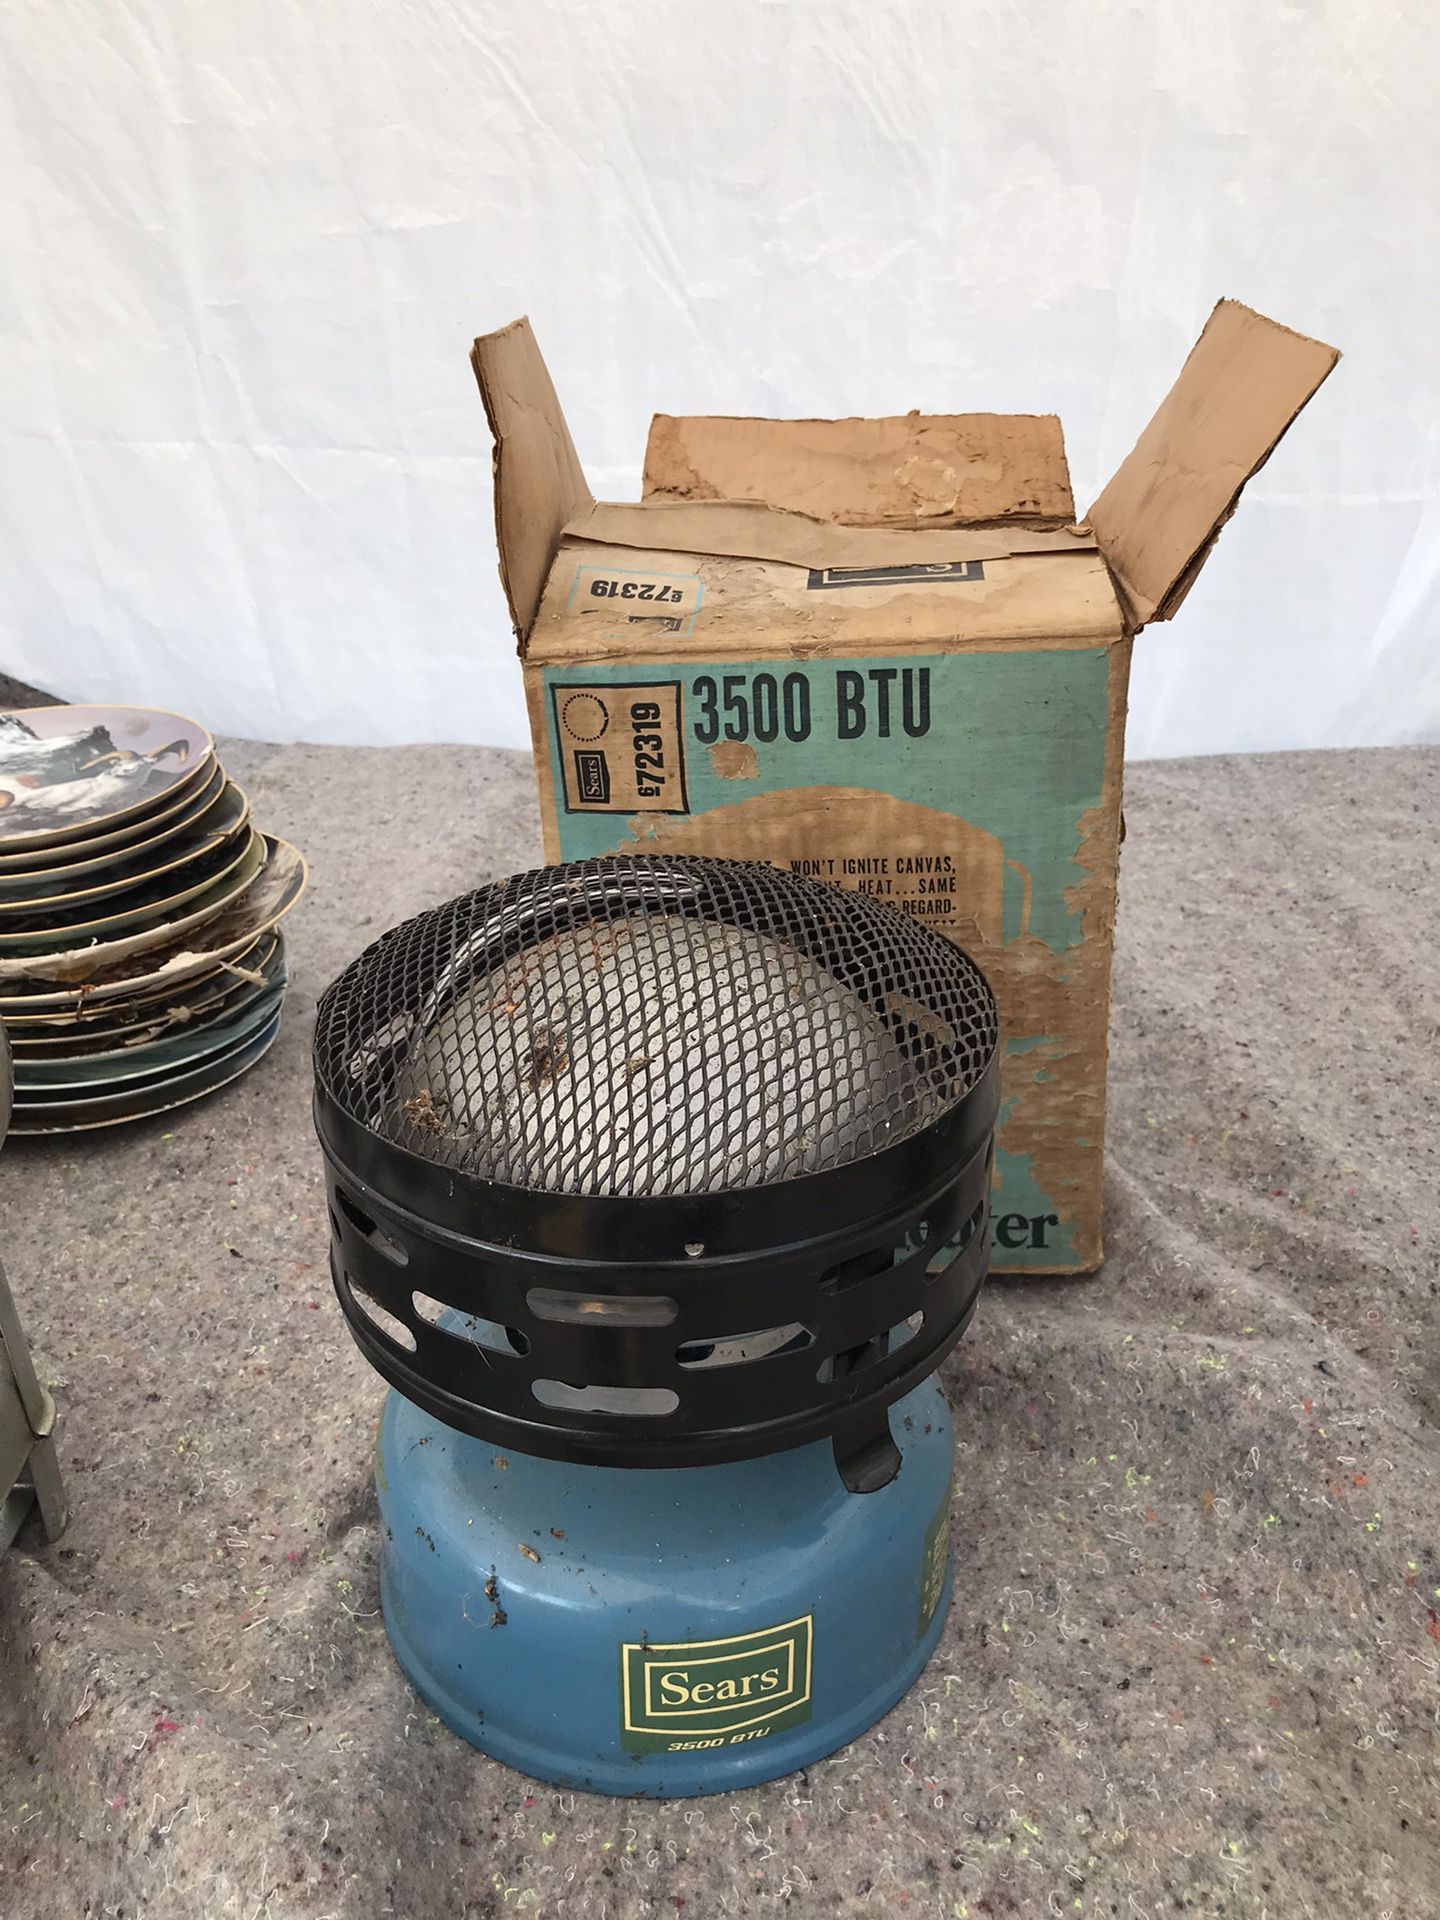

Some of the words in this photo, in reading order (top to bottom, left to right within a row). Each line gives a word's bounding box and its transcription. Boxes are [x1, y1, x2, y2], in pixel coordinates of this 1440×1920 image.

[591, 579, 683, 603] 672319
[692, 671, 811, 744] 3500
[836, 667, 930, 739] BTU
[630, 702, 665, 797] 672319
[586, 759, 600, 796] Sears
[791, 858, 834, 876] WON'T
[842, 858, 889, 875] IGNITE
[896, 855, 957, 874] CANVAS,
[903, 898, 957, 917] REGARD-
[659, 1667, 780, 1706] Sears
[667, 1736, 726, 1752] 3500
[729, 1726, 771, 1745] BTU
